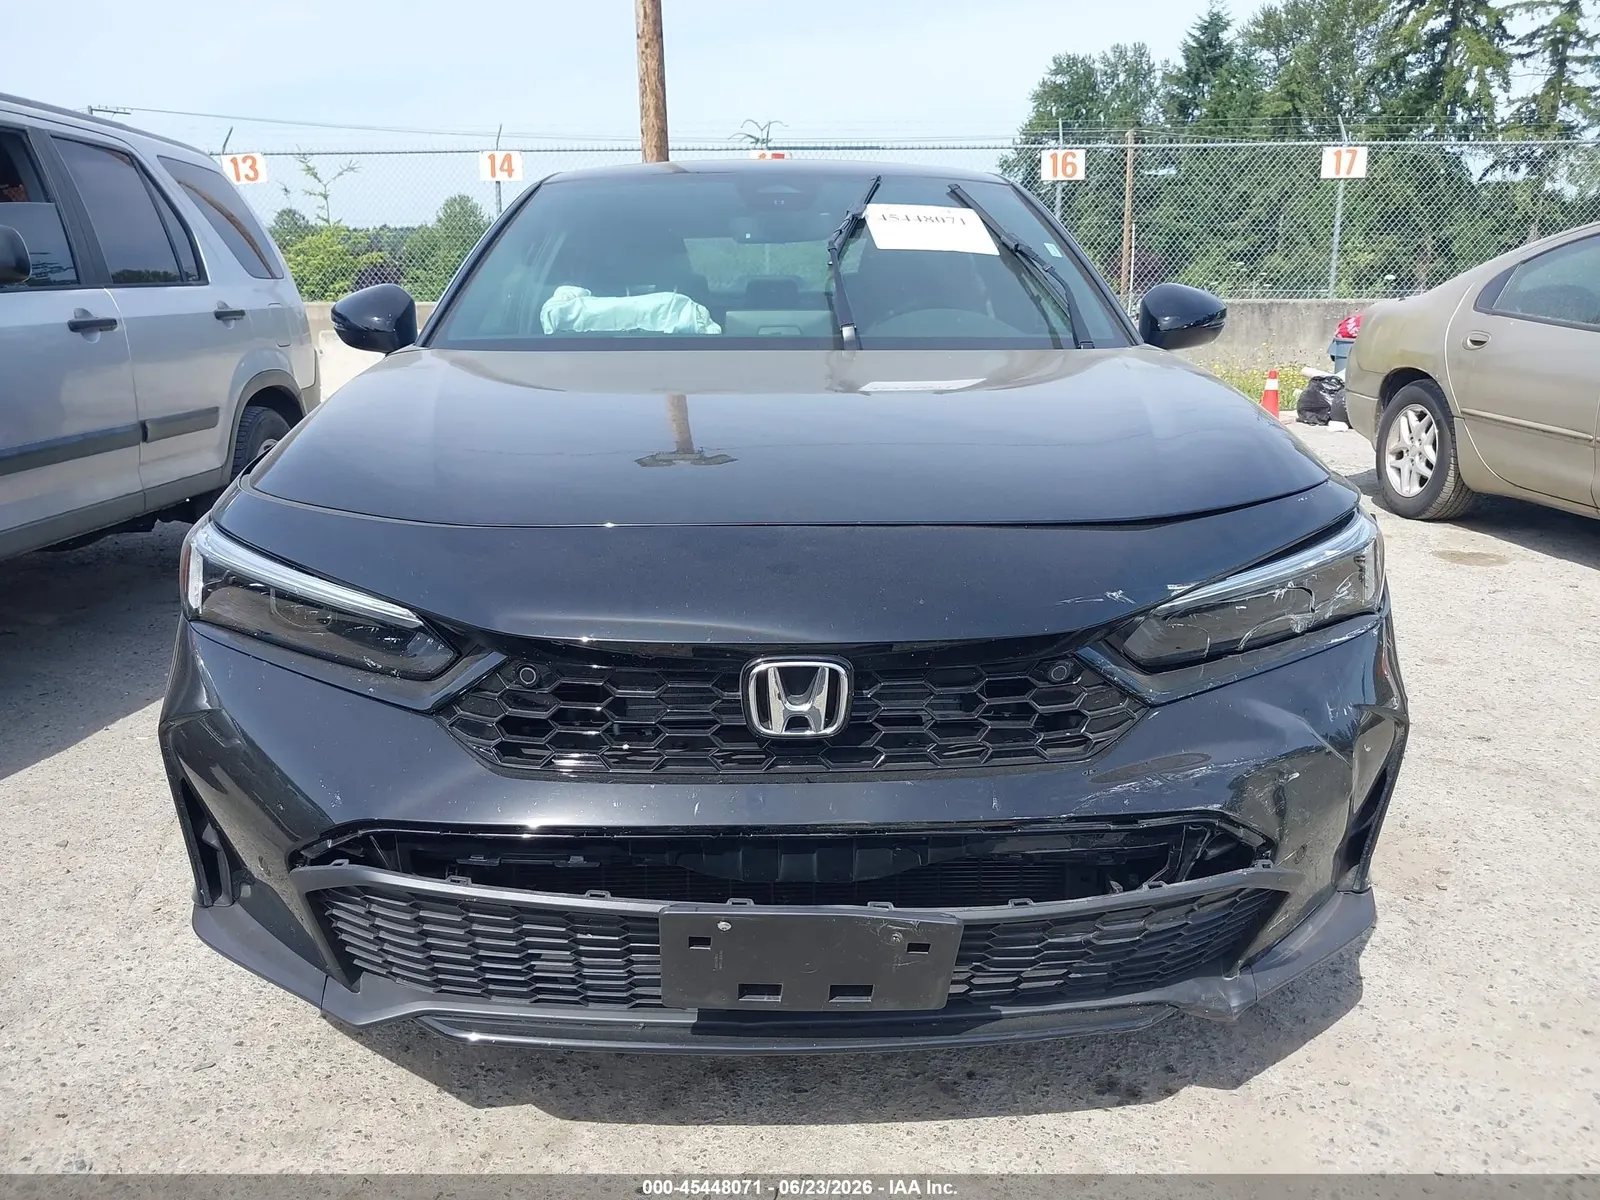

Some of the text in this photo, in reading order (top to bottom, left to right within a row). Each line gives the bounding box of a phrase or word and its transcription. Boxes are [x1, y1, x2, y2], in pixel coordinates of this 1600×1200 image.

[230, 155, 259, 182] 13
[488, 153, 515, 178] 14
[1050, 151, 1078, 178] 16
[1333, 149, 1358, 175] 17
